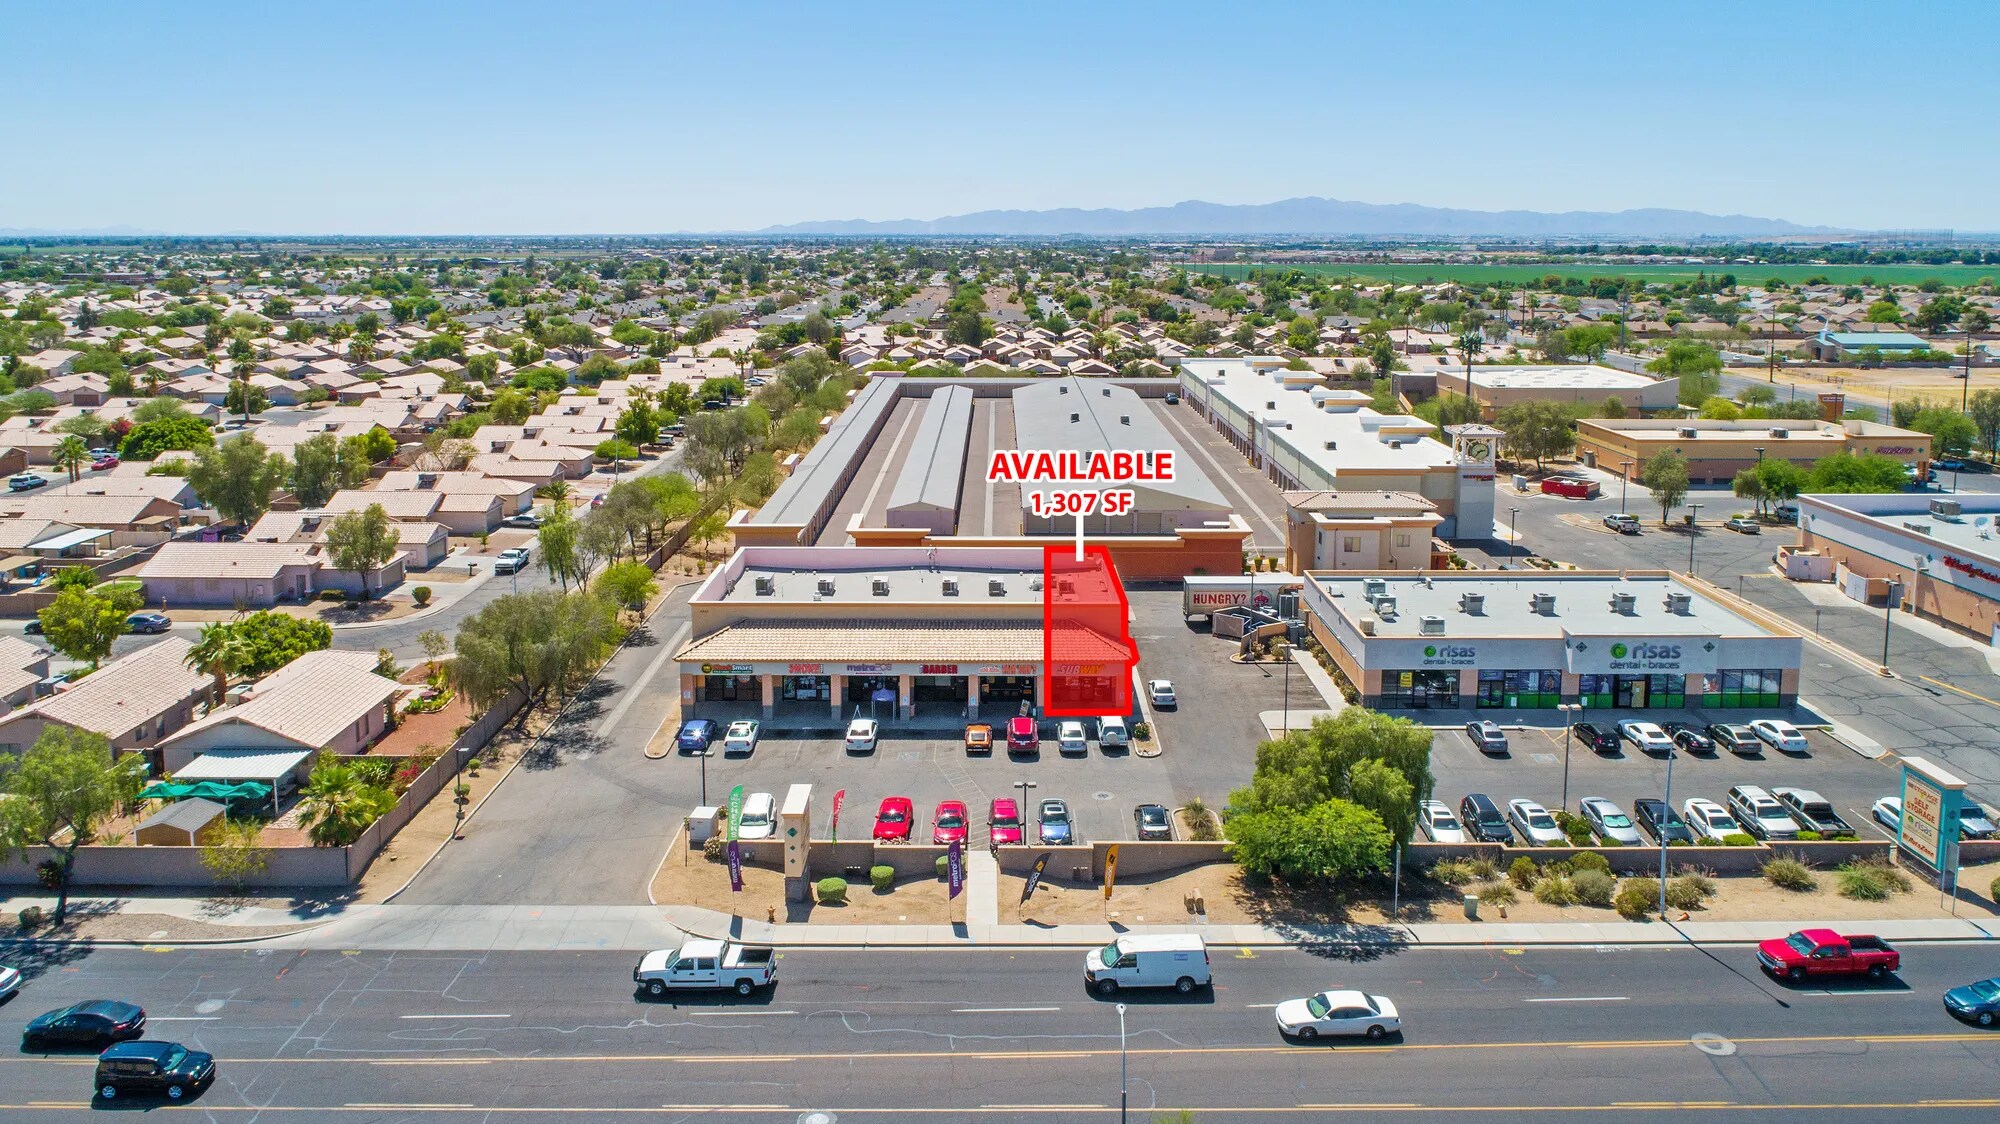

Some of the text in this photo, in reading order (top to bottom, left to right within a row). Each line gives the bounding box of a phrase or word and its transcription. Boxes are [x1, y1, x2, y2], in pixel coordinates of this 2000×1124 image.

[1193, 593, 1247, 605] HUNGRY?
[1439, 645, 1475, 658] risas
[1632, 642, 1681, 659] risas
[922, 664, 958, 674] BARBER
[1057, 664, 1104, 675] SUBWAY
[1610, 660, 1680, 670] dental braces
[1914, 796, 1930, 811] SELF
[1906, 800, 1936, 825] STORAGE
[1914, 820, 1933, 838] risas
[950, 851, 959, 887] metroPCS
